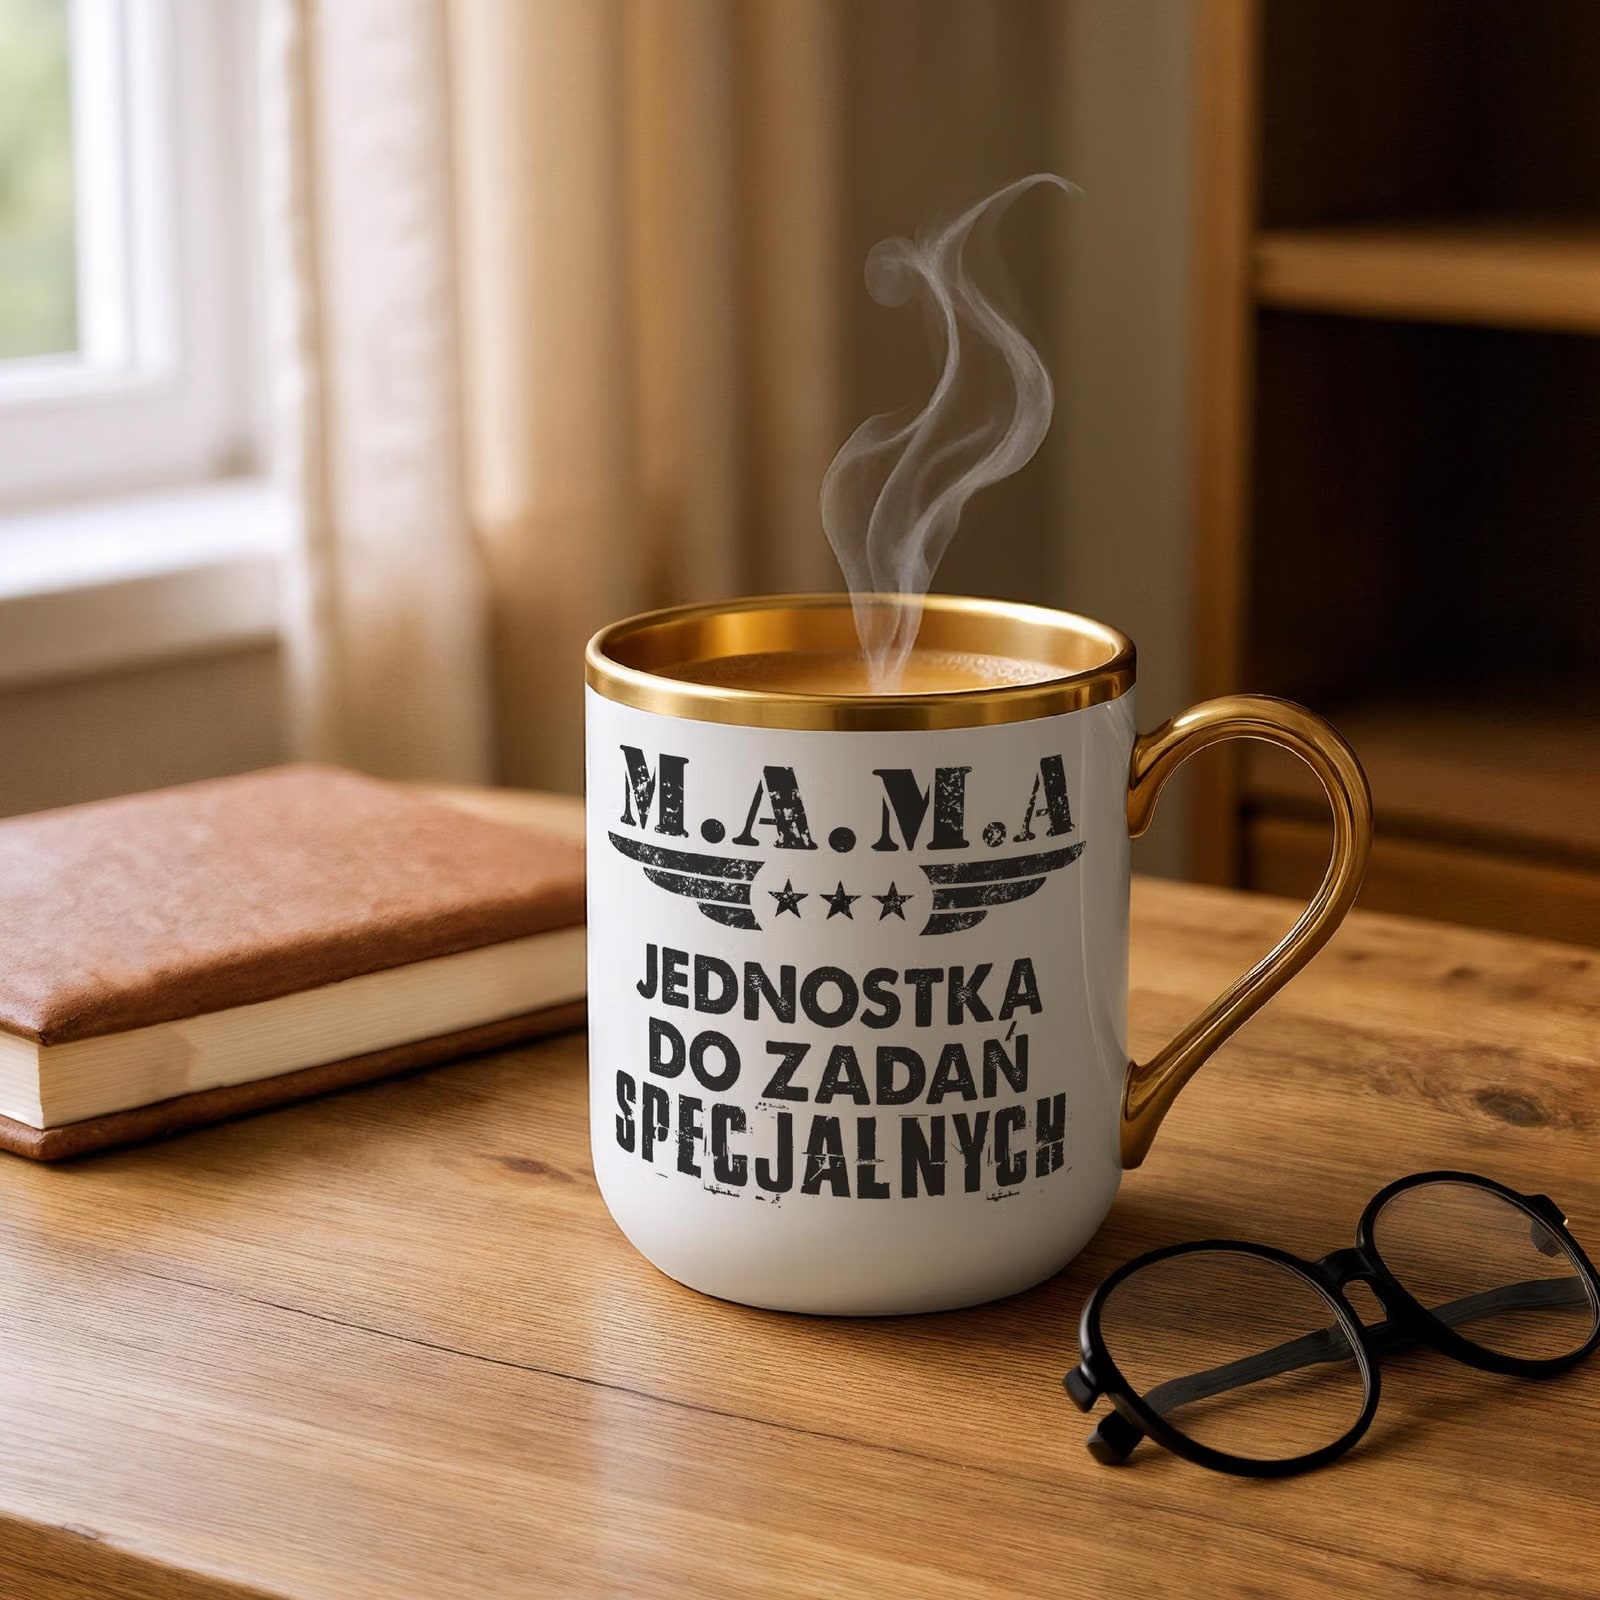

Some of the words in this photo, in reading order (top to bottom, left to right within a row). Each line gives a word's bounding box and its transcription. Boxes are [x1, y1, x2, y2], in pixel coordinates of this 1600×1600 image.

[618, 745, 1076, 853] M.A.M.A
[637, 944, 1043, 1029] JEDNOSTKA
[649, 1017, 740, 1092] DO
[762, 1020, 1030, 1106] ZADAŃ
[615, 1070, 1066, 1200] SPECJALNYCH
